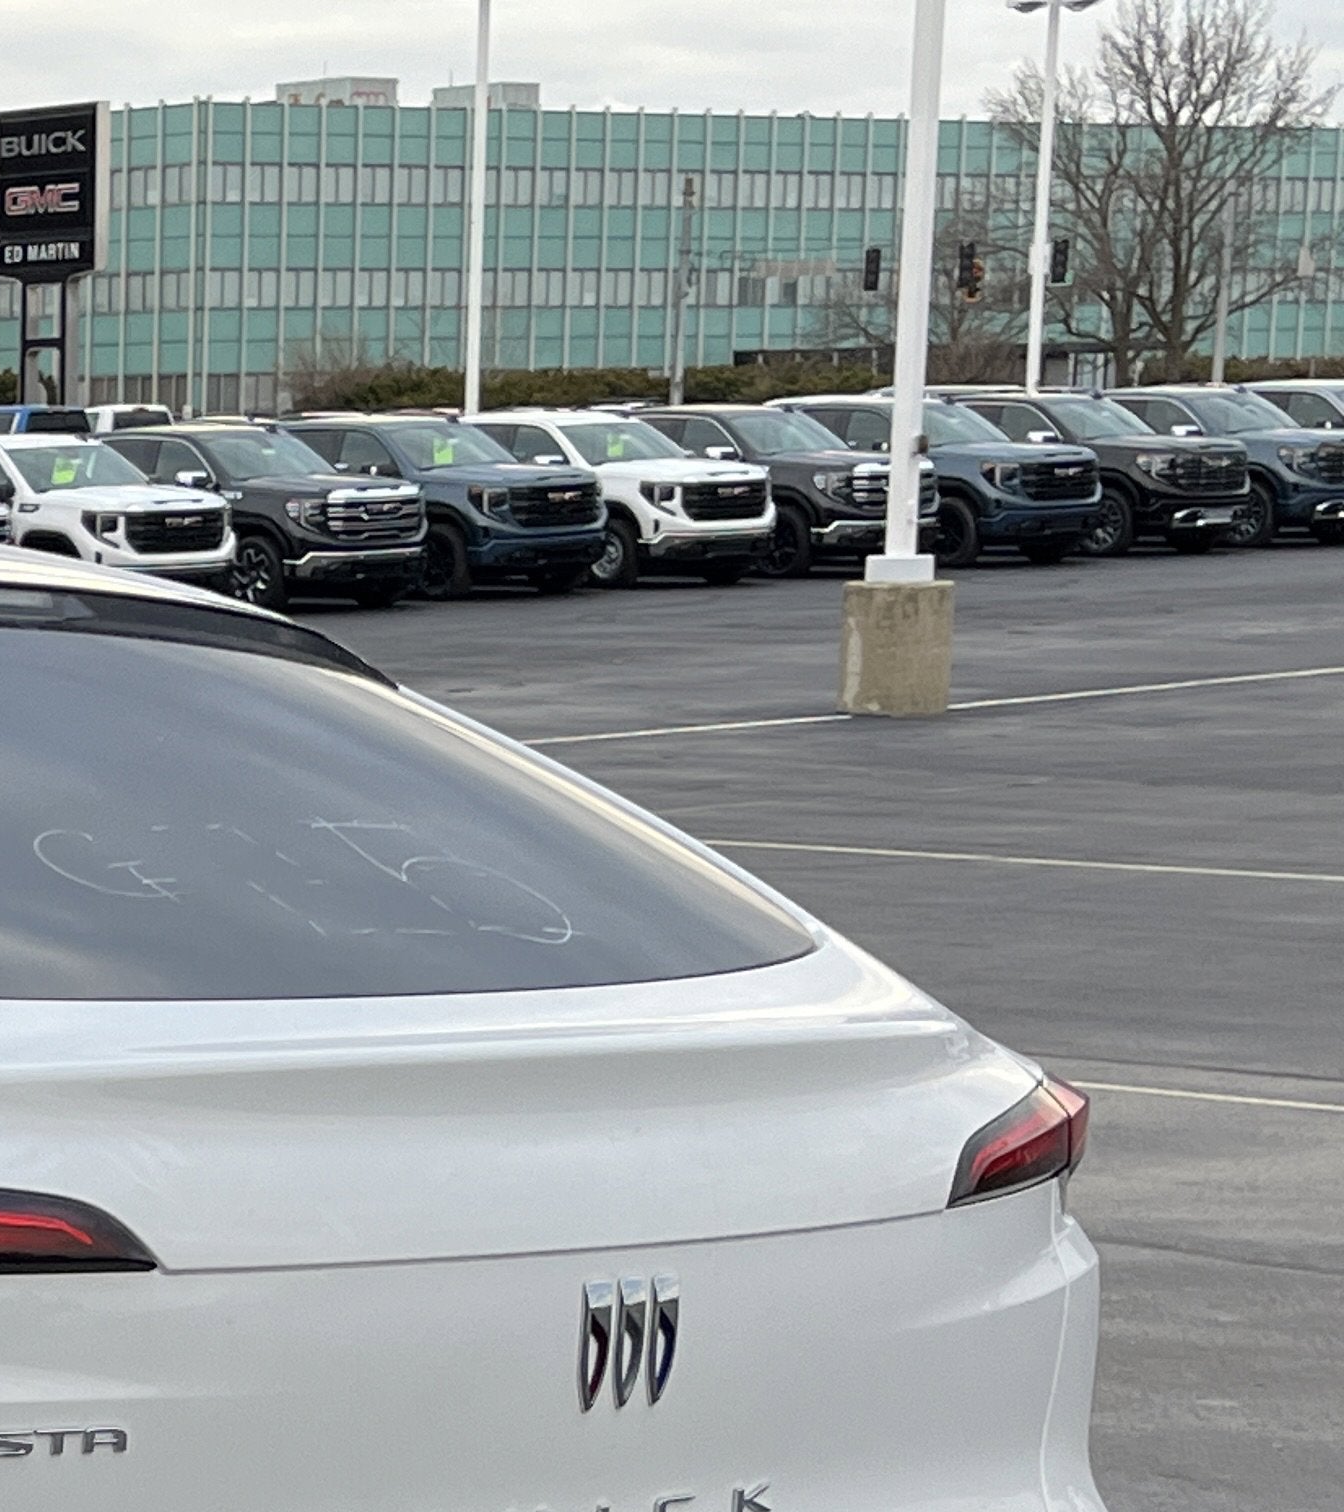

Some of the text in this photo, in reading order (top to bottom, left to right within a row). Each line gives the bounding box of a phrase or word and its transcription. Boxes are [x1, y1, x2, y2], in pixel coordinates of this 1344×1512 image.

[0, 129, 87, 159] BUICK
[4, 182, 81, 217] GMC
[3, 241, 81, 264] ED MARTIN
